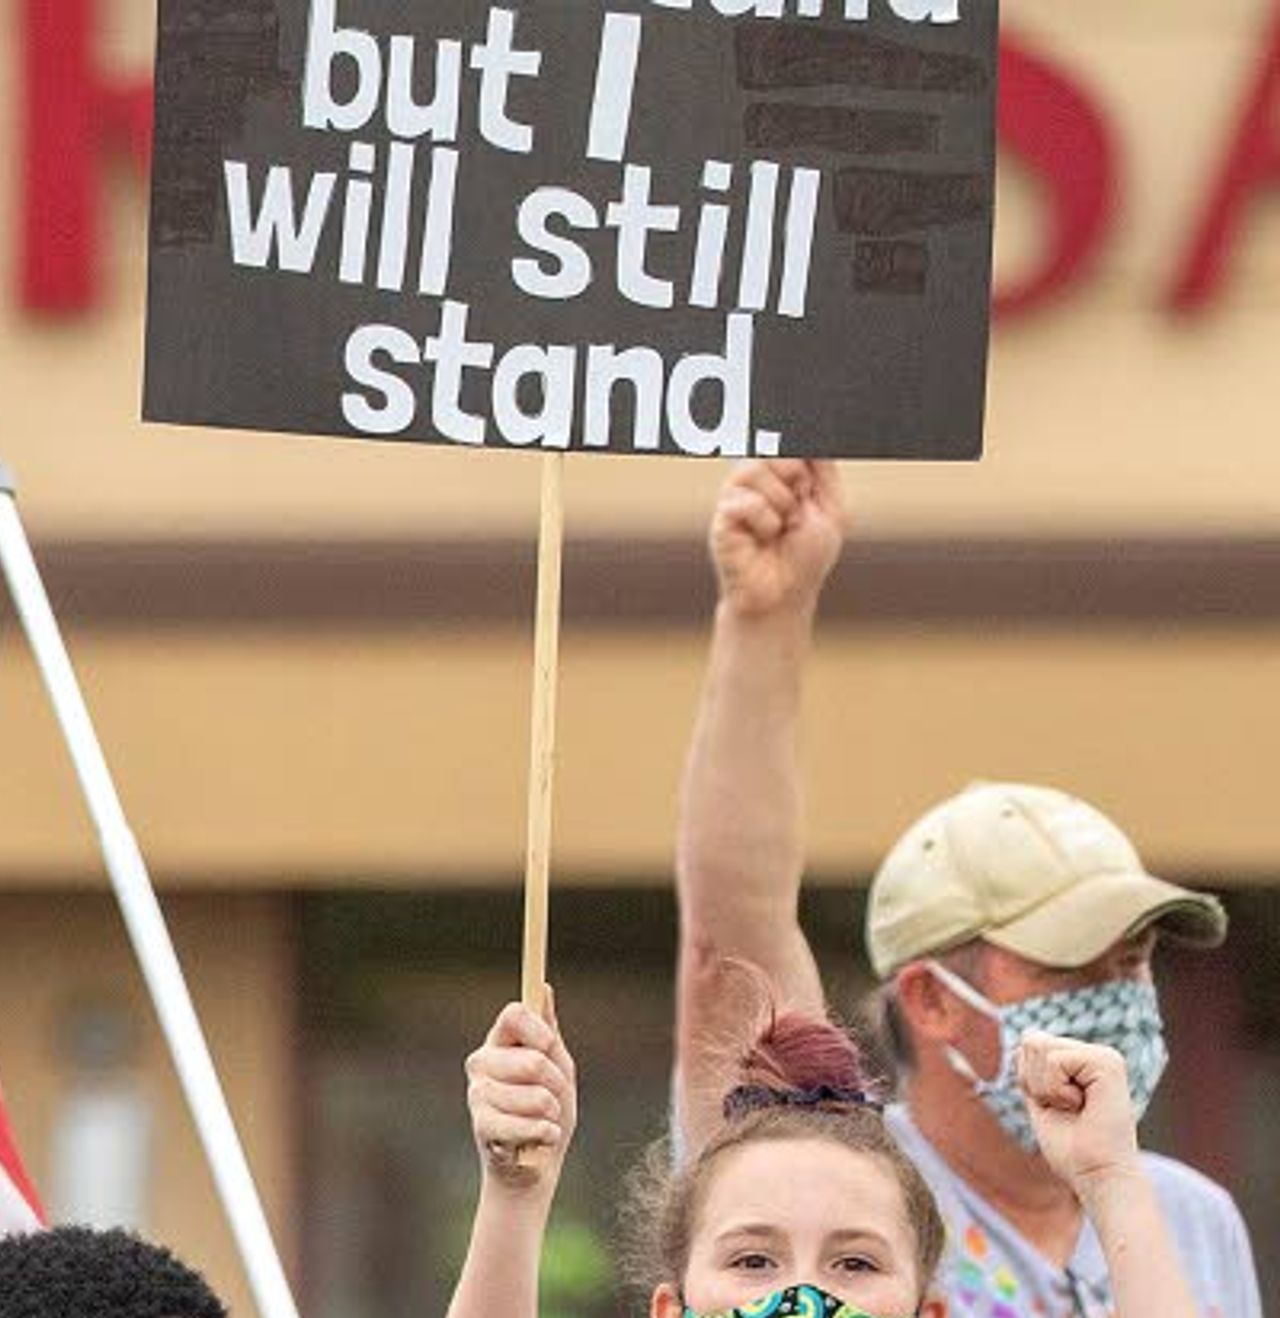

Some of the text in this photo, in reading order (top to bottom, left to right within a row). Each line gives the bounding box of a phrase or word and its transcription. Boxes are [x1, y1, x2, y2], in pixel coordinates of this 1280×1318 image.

[302, 0, 642, 163] but I
[223, 143, 460, 296] will
[511, 161, 821, 321] still
[337, 295, 787, 460] stand.
